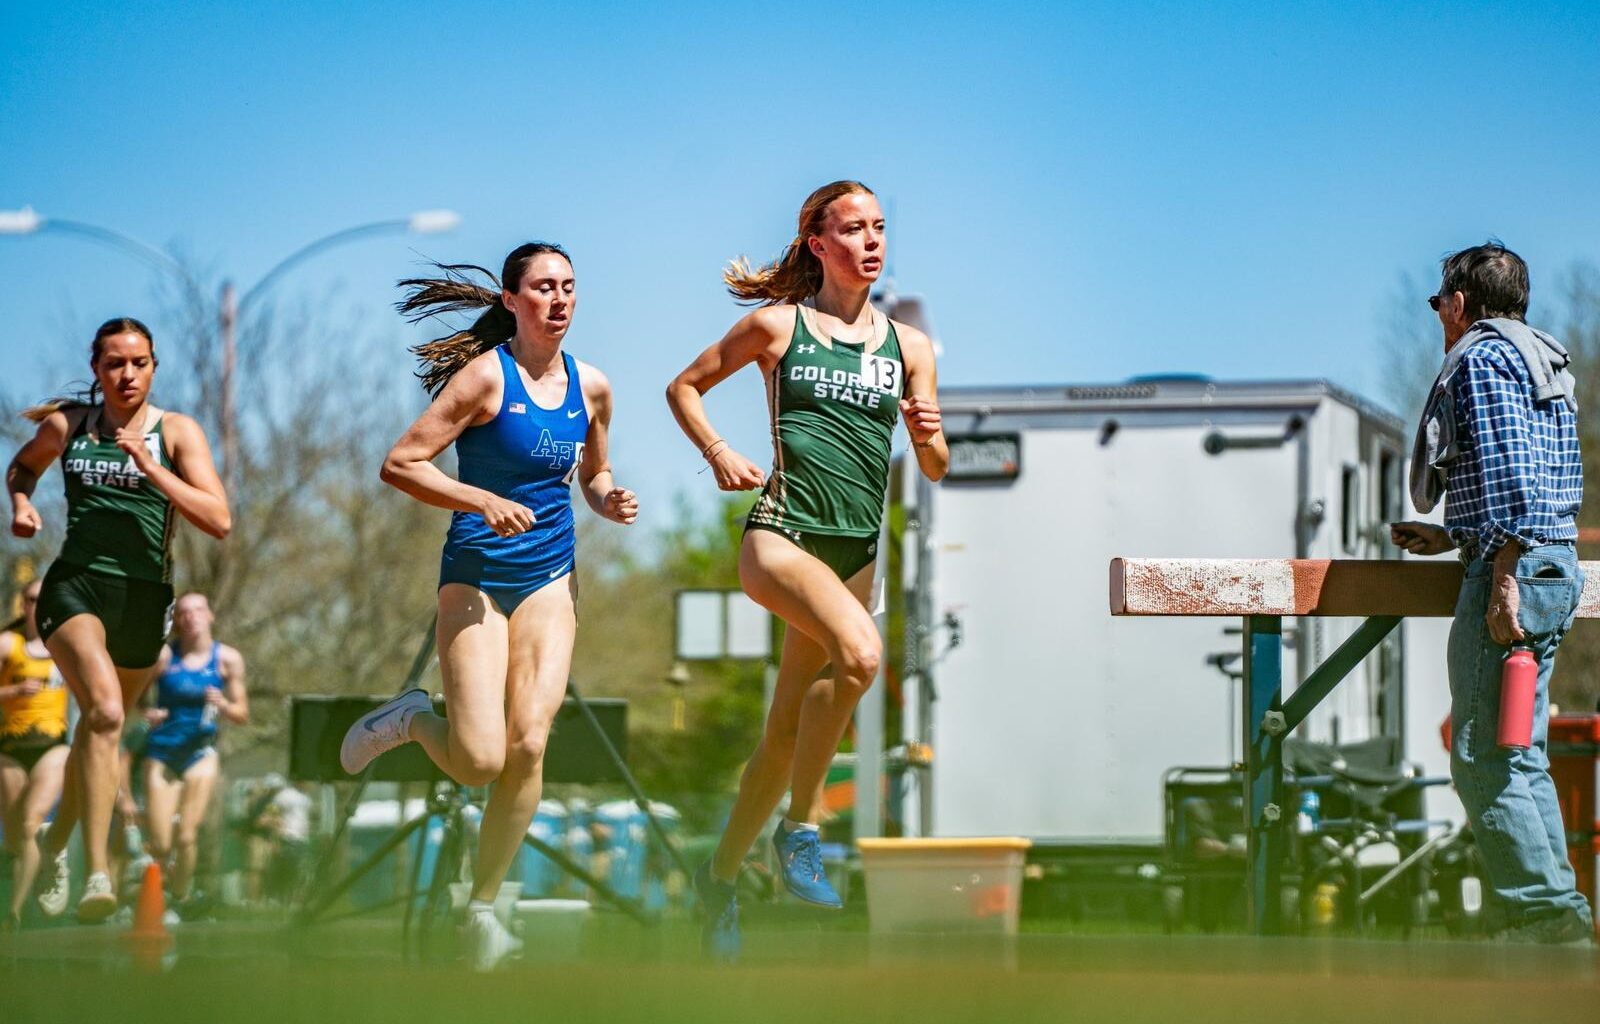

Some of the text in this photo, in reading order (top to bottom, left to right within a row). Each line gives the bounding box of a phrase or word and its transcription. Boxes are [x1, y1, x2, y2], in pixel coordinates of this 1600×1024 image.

[790, 366, 890, 394] COLOR
[870, 358, 896, 390] 13
[814, 383, 881, 409] STATE
[531, 428, 574, 470] AF
[81, 473, 139, 489] STATE
